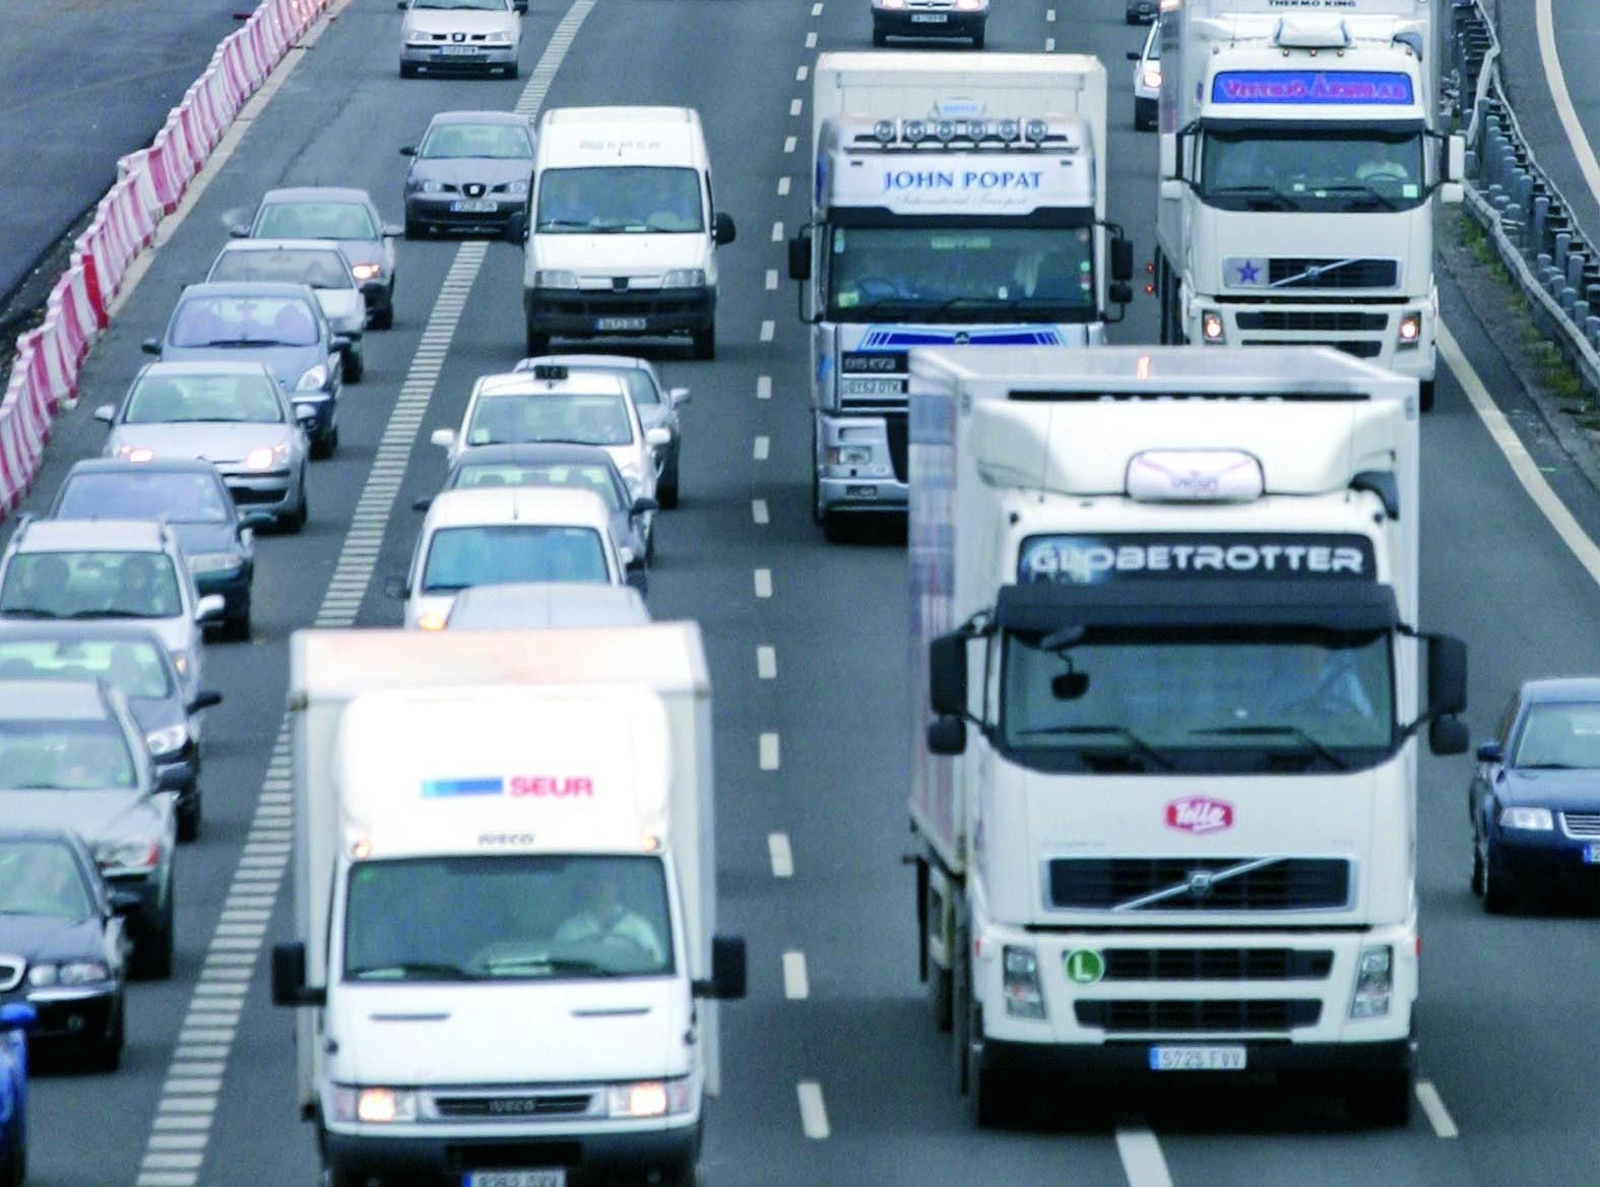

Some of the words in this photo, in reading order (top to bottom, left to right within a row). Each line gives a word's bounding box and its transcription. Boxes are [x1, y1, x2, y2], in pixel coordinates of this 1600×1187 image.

[1325, 0, 1356, 8] KING
[884, 170, 954, 192] JOHN
[964, 171, 1043, 189] POPAT
[1029, 546, 1364, 573] GLOBETROTTER
[510, 776, 593, 798] SEUR
[1074, 954, 1092, 980] L
